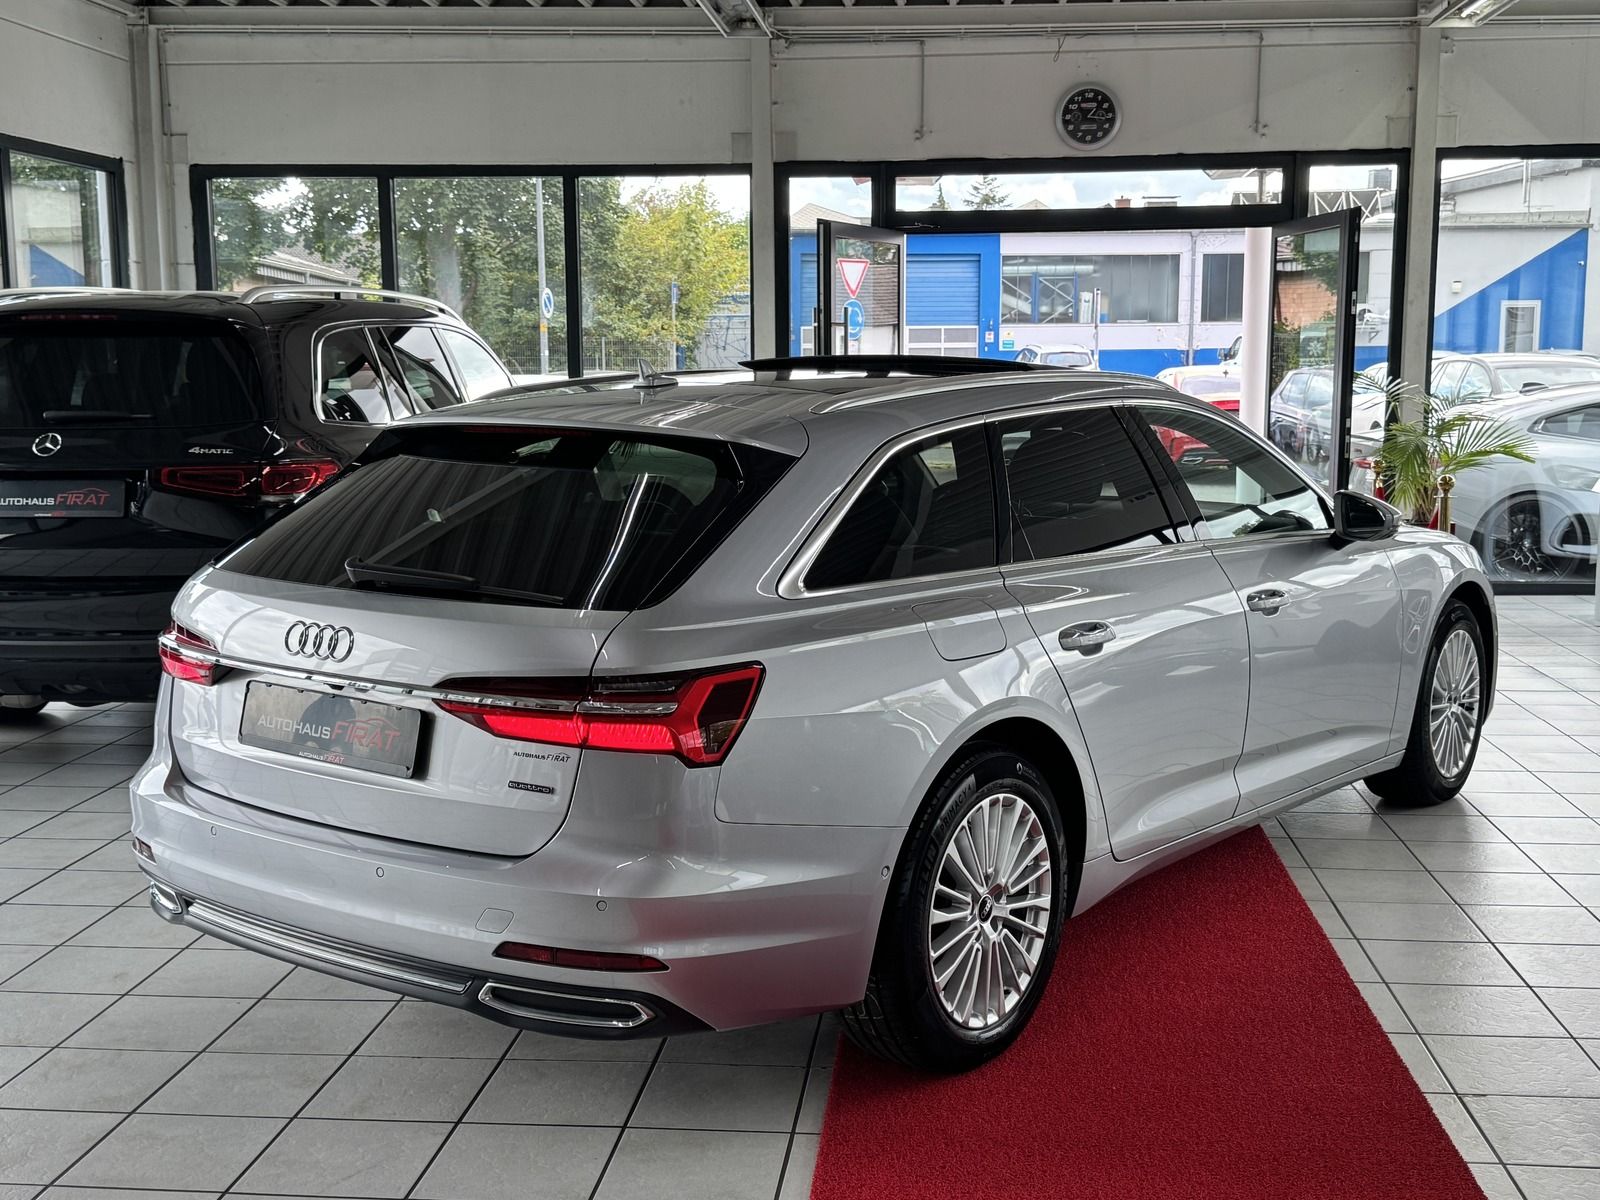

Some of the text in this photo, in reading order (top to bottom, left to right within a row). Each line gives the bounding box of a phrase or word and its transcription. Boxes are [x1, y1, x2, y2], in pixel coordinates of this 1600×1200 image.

[188, 446, 234, 454] 4MATIC
[55, 493, 110, 505] FIRAT
[257, 714, 401, 752] AUTOHAUS FIRAT
[513, 751, 571, 763] AUTOHAUS FIRAT
[508, 781, 550, 794] quattro
[940, 786, 967, 832] PRIMACY
